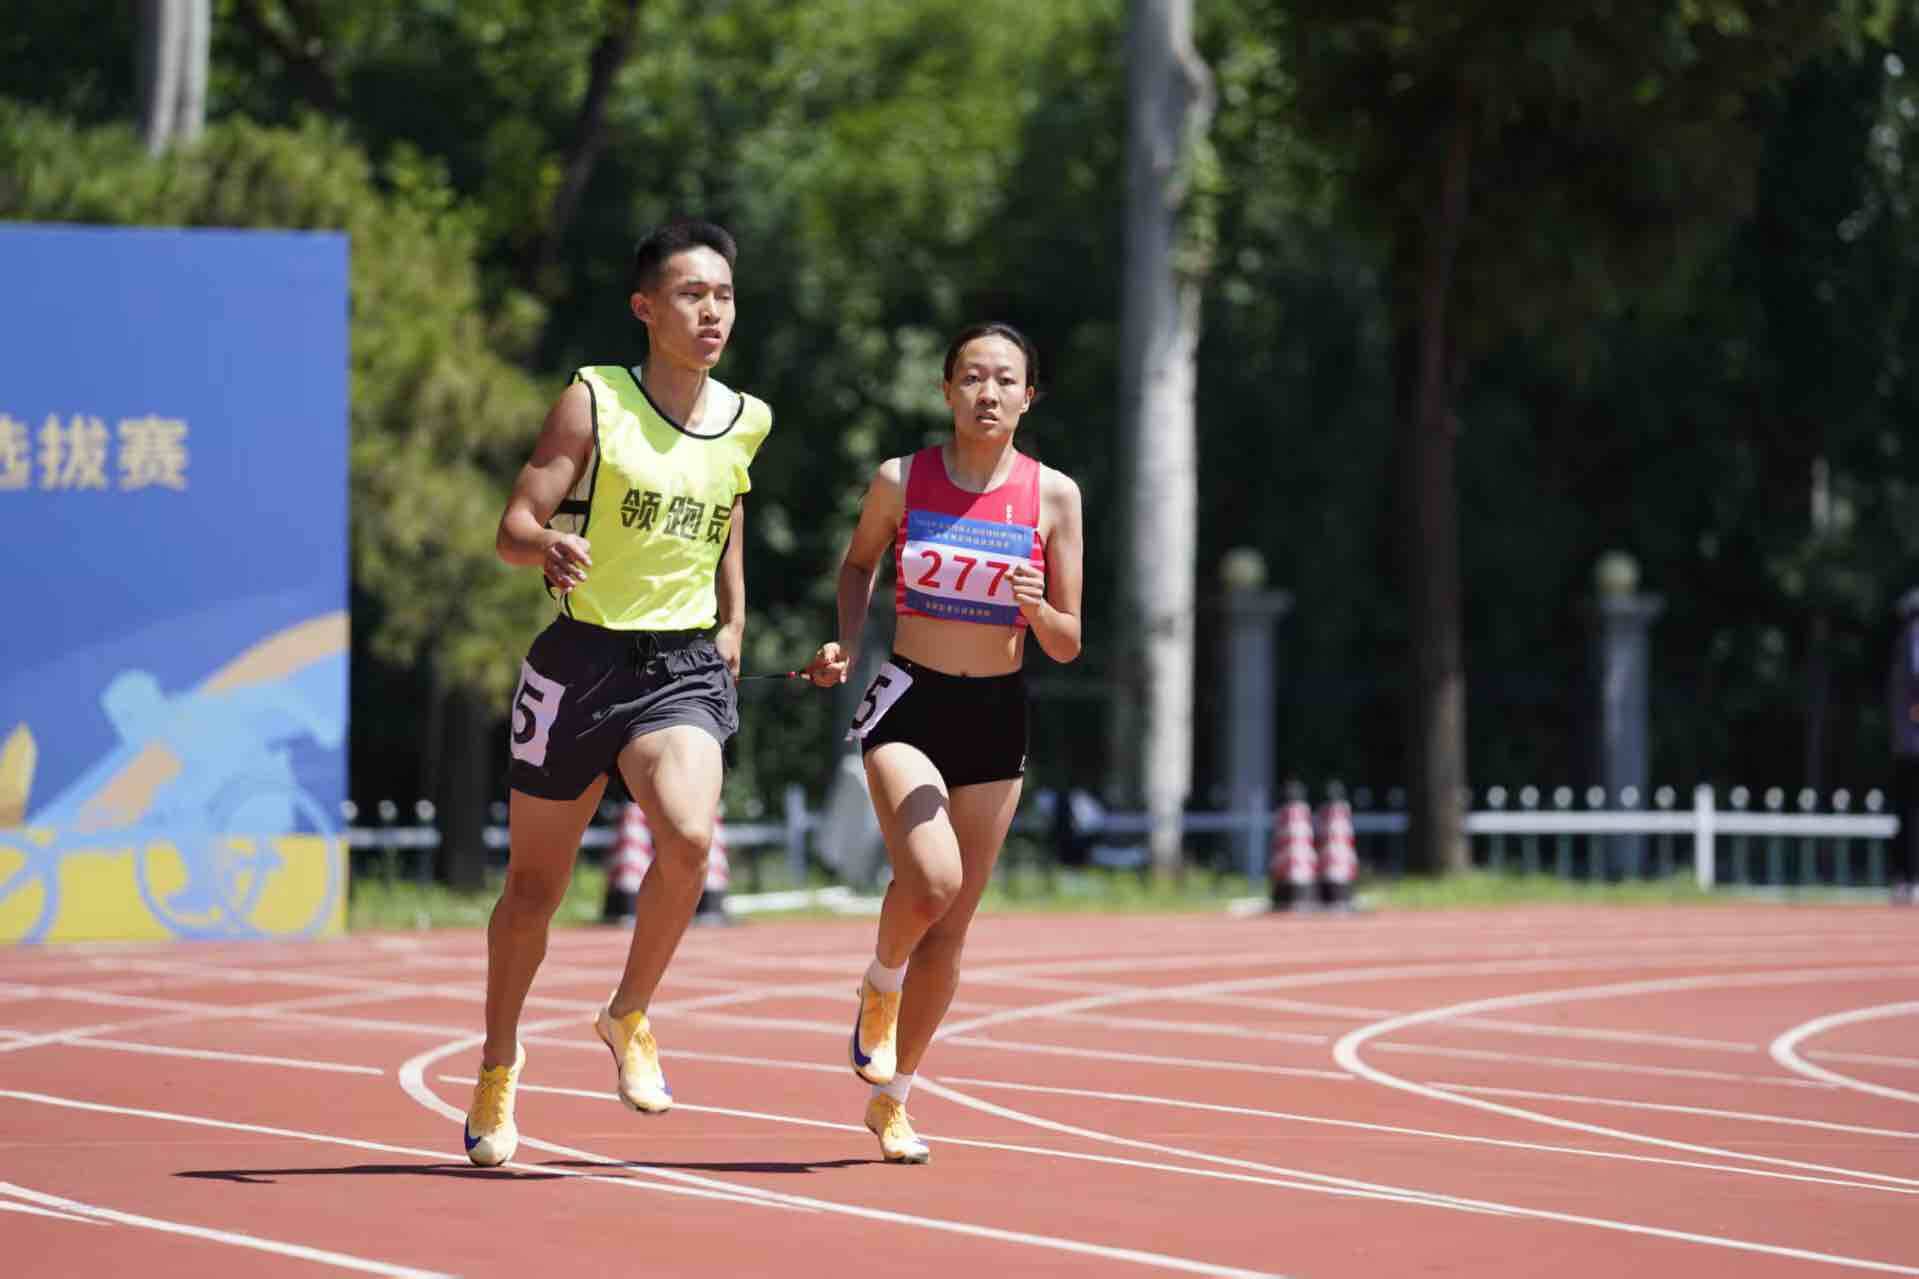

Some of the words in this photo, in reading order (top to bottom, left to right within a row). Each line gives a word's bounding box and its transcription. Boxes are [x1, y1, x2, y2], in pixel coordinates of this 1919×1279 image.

[918, 550, 1010, 597] 277
[513, 680, 545, 744] 5
[852, 674, 892, 730] 5
